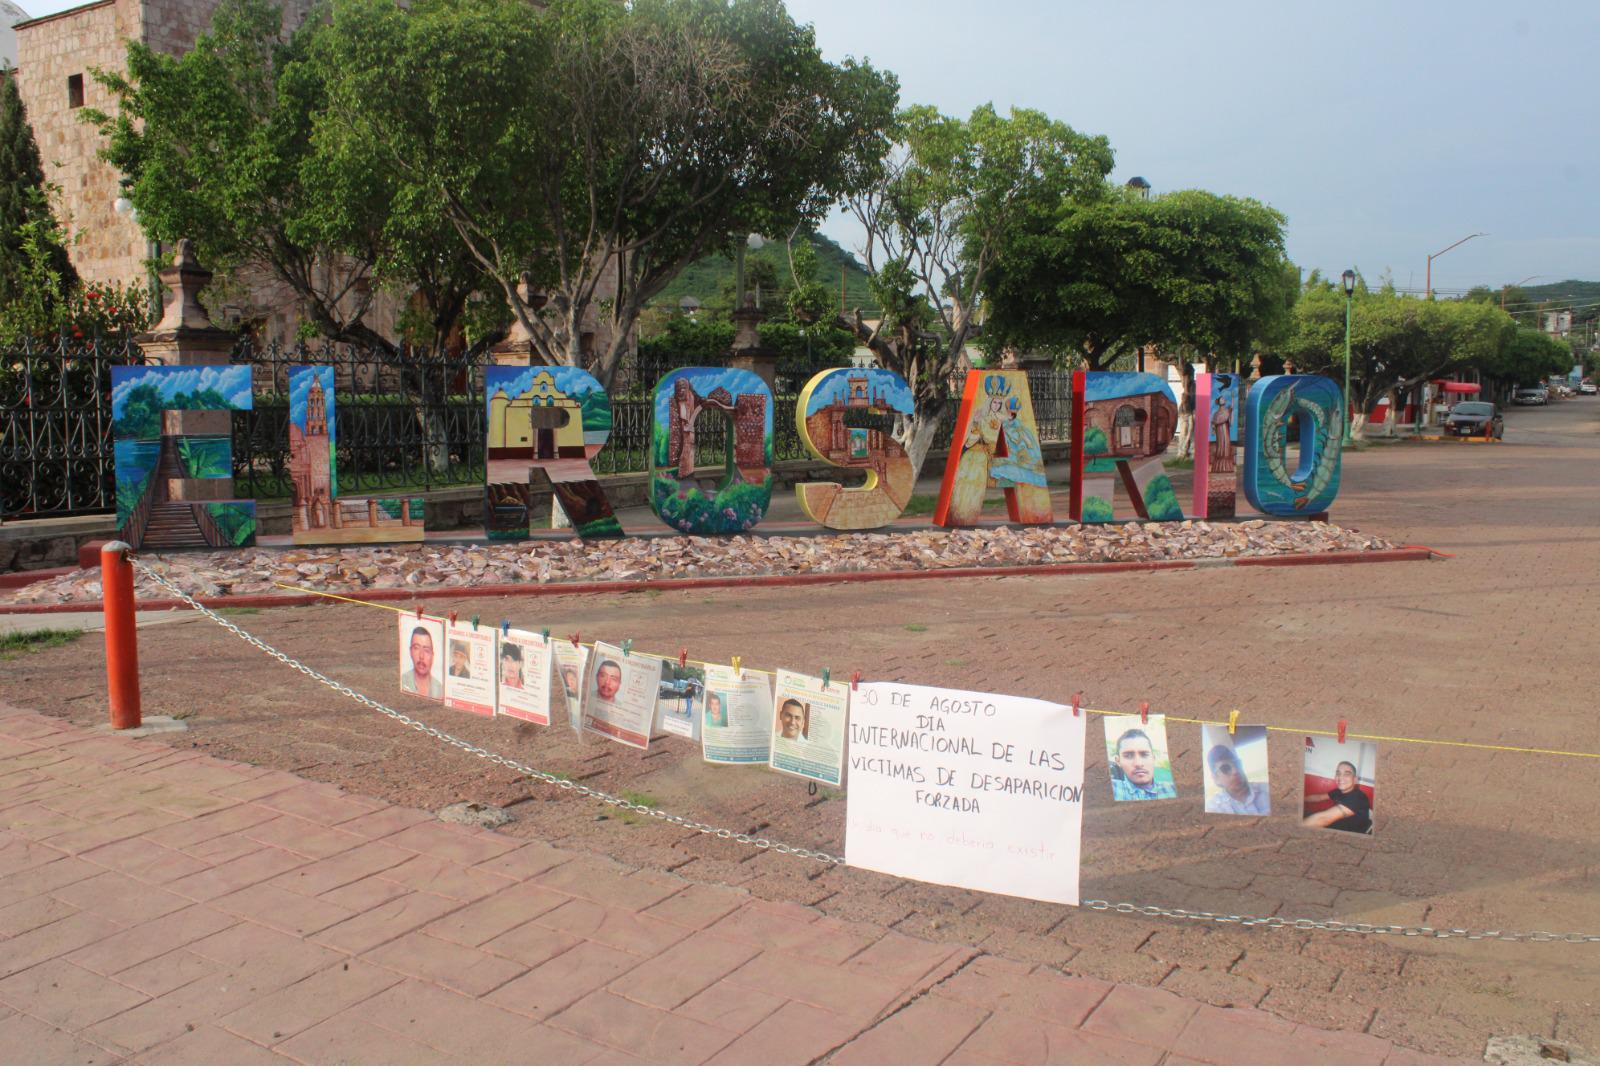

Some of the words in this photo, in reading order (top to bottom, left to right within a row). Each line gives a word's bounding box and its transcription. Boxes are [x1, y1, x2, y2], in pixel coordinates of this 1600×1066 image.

[111, 365, 425, 548] EL
[485, 365, 1342, 541] ROSARIO
[859, 688, 878, 707] 30
[891, 692, 911, 707] DE
[929, 696, 996, 717] AGOSTO
[916, 714, 946, 732] DIA
[851, 723, 983, 756] INTERNACIONAL
[991, 742, 1015, 762] DE
[1029, 749, 1065, 771] LAS
[851, 756, 925, 783] VICTIMAS
[935, 767, 956, 787] DE
[971, 772, 1084, 803] DESAPARICION
[915, 789, 980, 814] FORZADA
